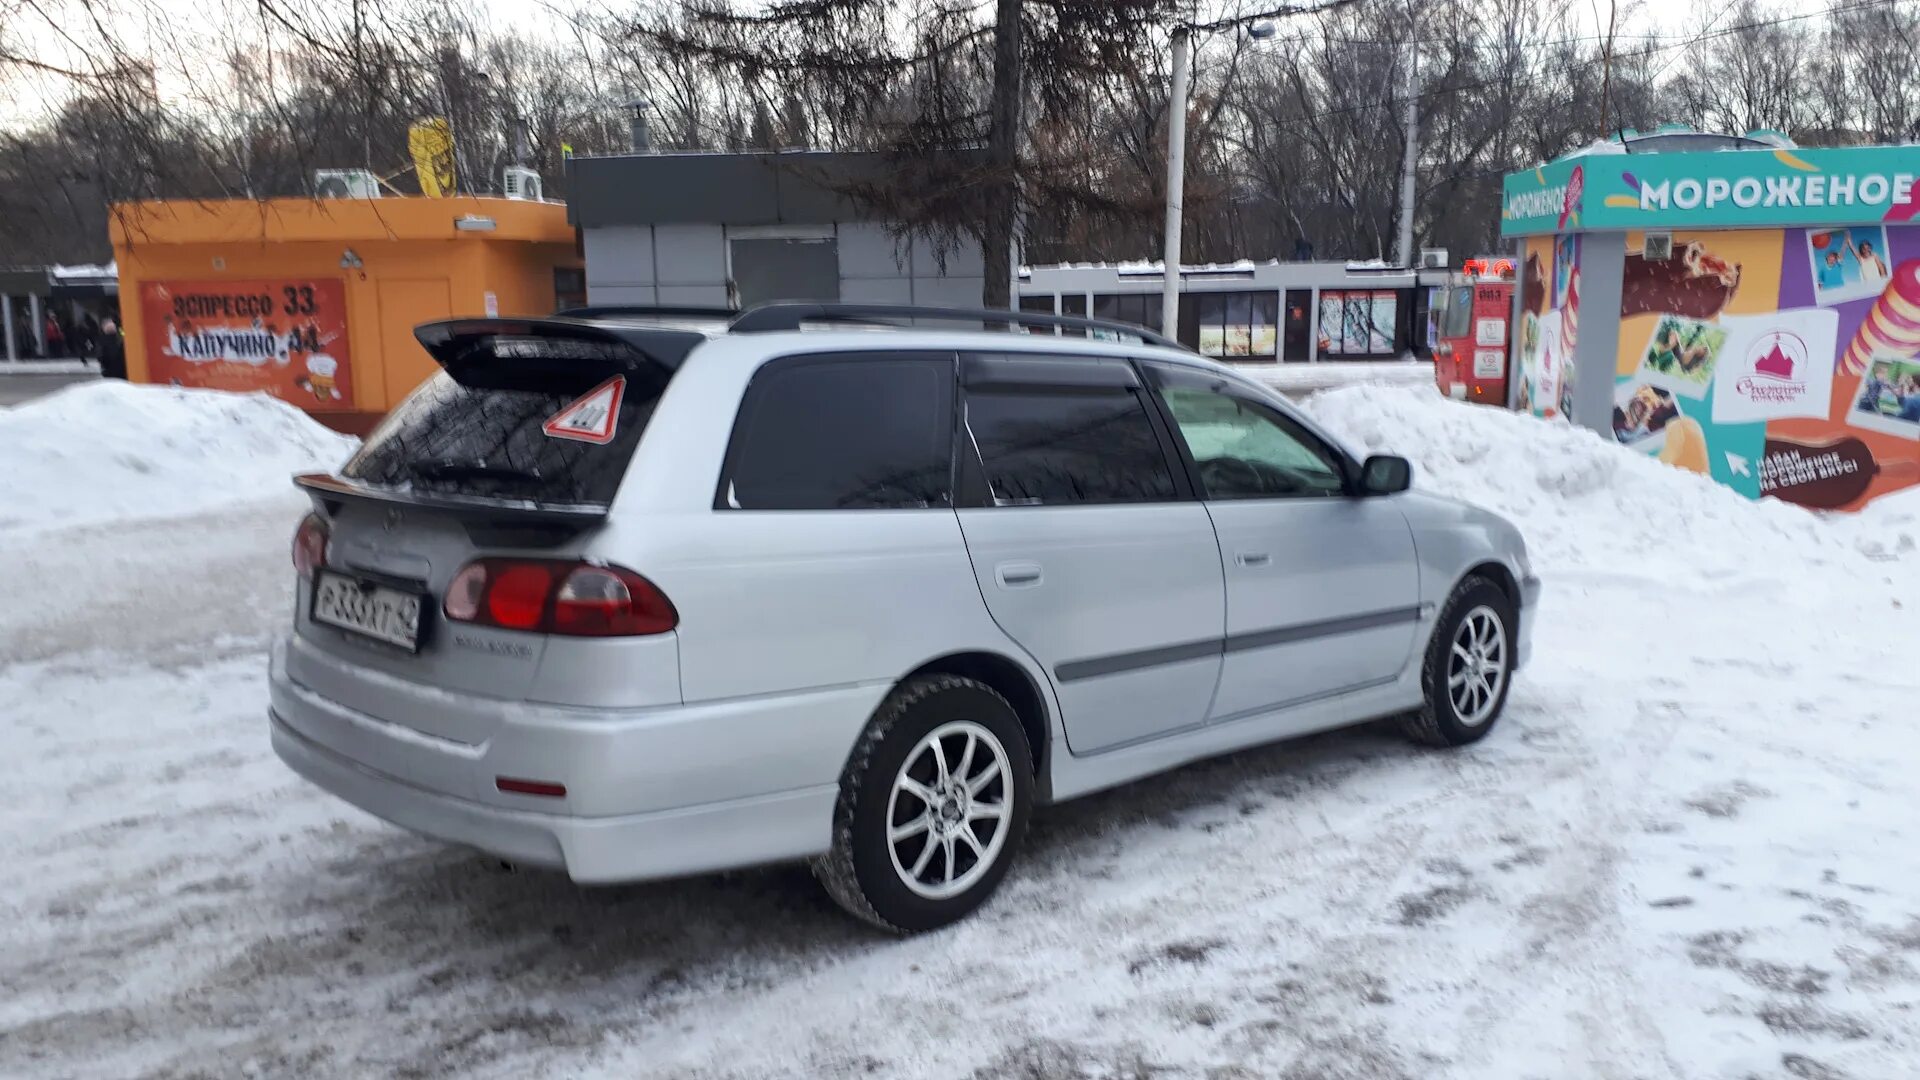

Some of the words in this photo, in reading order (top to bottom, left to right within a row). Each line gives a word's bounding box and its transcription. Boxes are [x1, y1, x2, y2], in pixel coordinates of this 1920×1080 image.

[1640, 173, 1913, 210] МОРОЖЕНОЕ
[173, 293, 273, 318] ЭСПРЕССО
[178, 331, 277, 358] КАПУЧИНО
